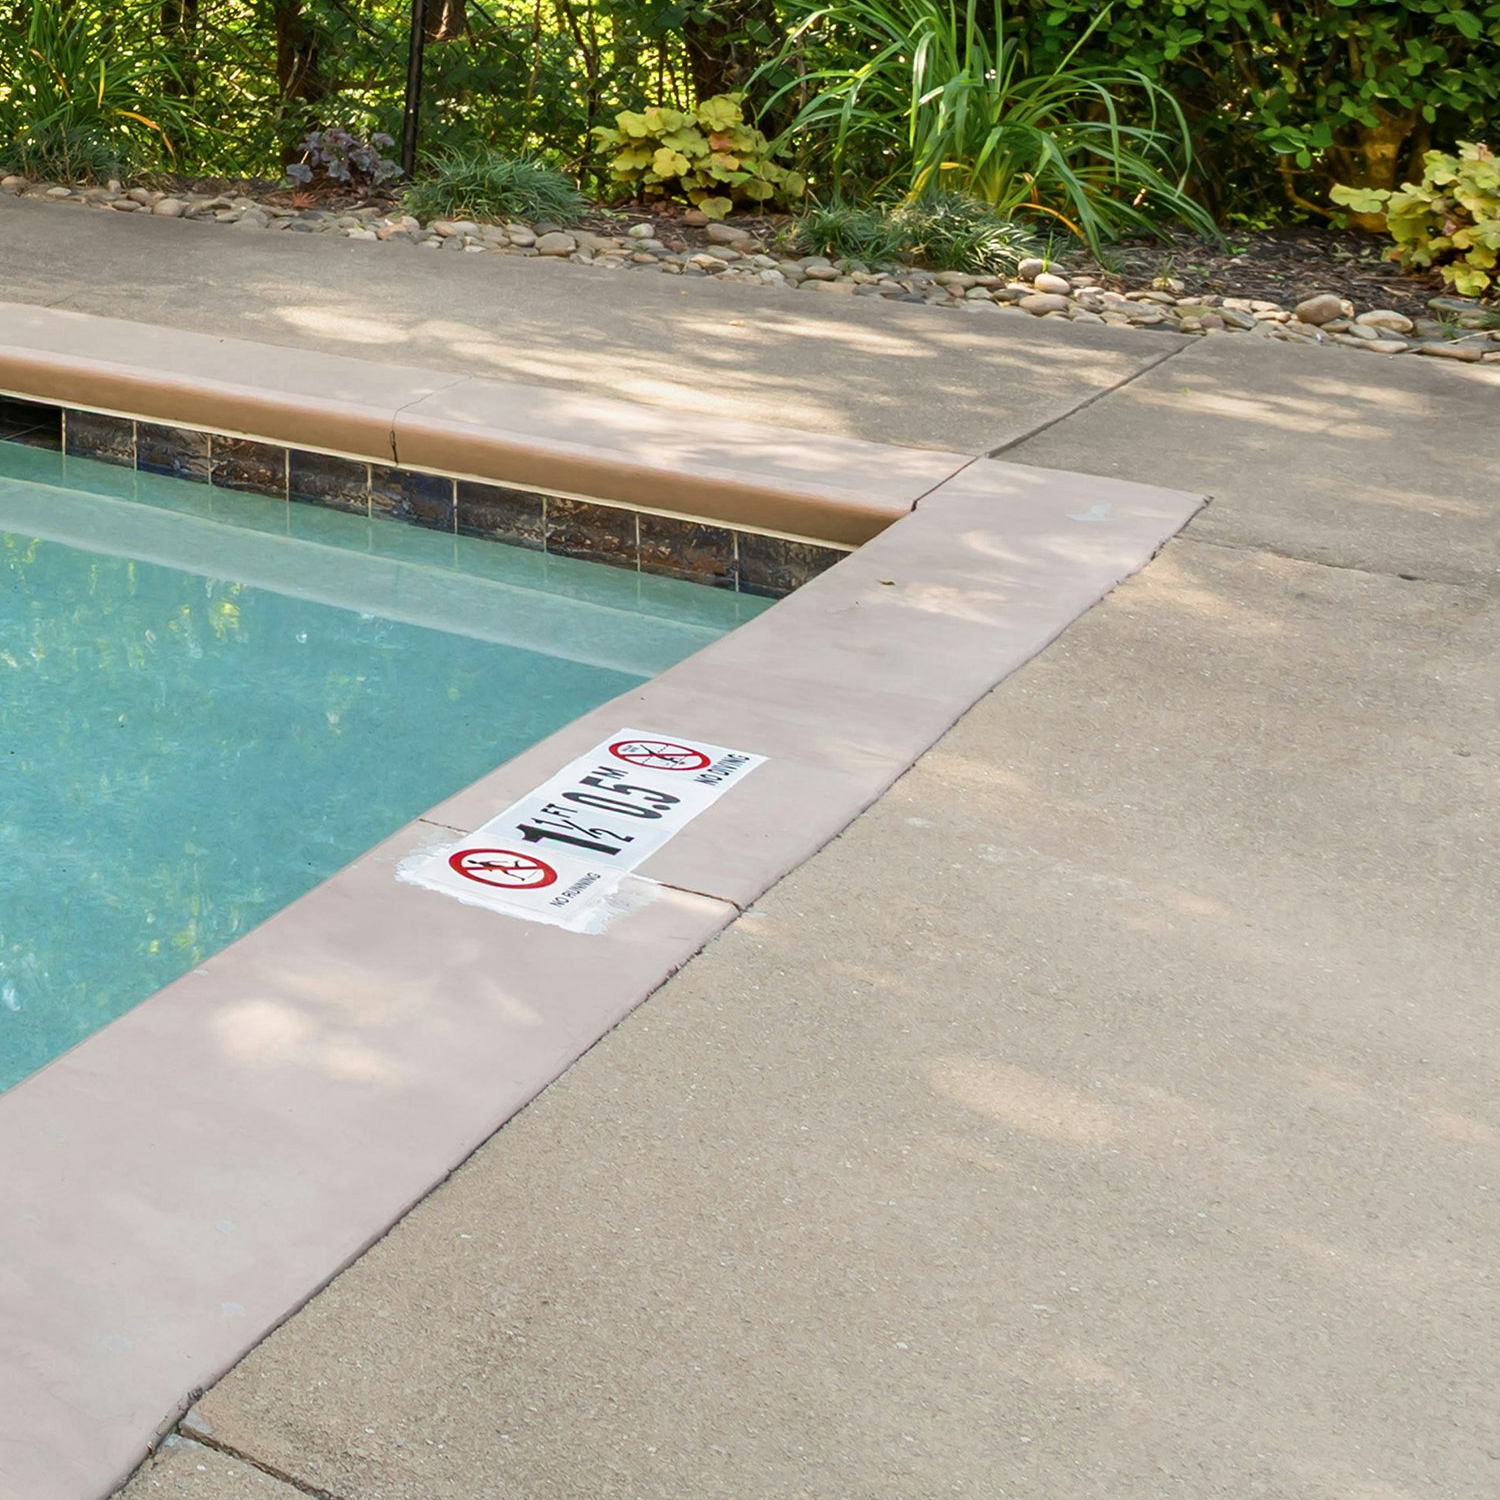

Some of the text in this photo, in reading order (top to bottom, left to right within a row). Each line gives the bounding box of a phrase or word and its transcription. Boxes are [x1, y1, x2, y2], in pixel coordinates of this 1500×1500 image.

[590, 765, 630, 780] M
[692, 753, 750, 787] NO DIVING
[540, 802, 579, 819] FT
[561, 775, 682, 820] 0.5
[549, 871, 601, 908] NO RUNNING
